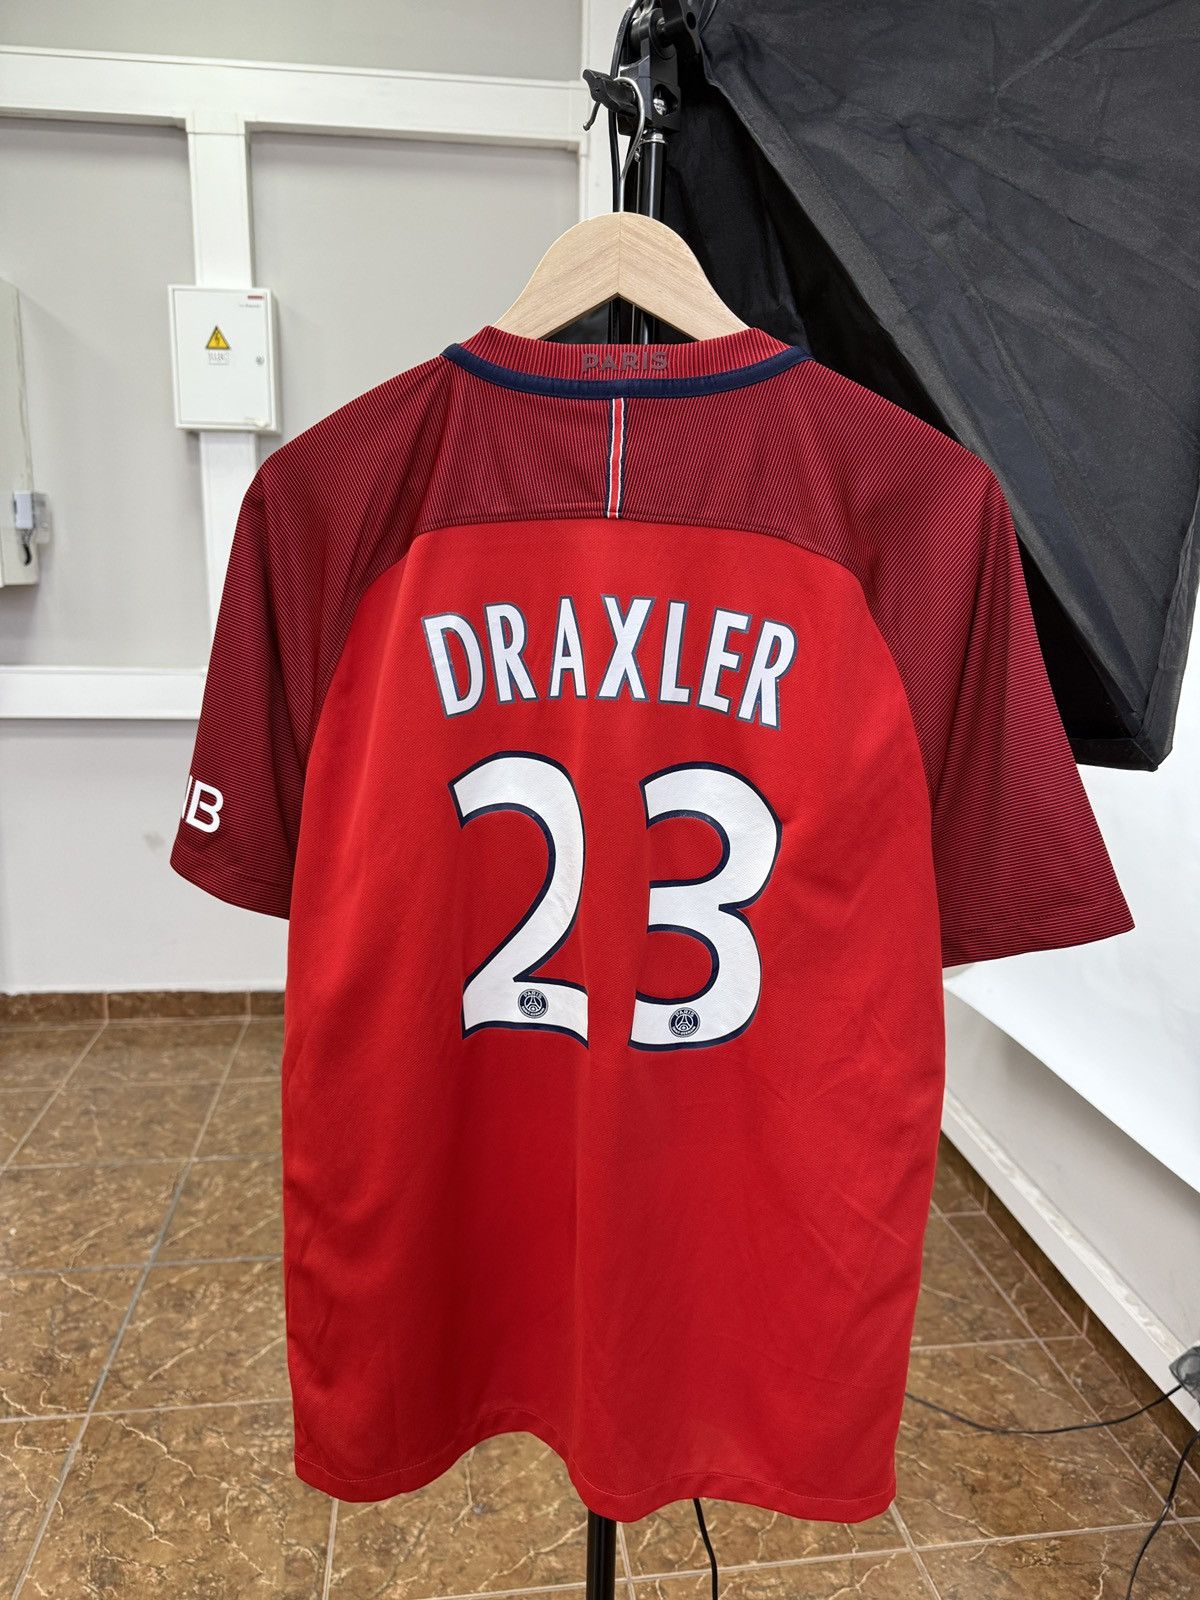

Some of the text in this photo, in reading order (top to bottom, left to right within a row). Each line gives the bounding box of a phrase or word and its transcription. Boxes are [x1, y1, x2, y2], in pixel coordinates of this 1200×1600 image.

[582, 351, 668, 372] PARIS
[421, 595, 798, 730] DRAXLER
[181, 774, 224, 833] B
[448, 750, 783, 1052] 23
